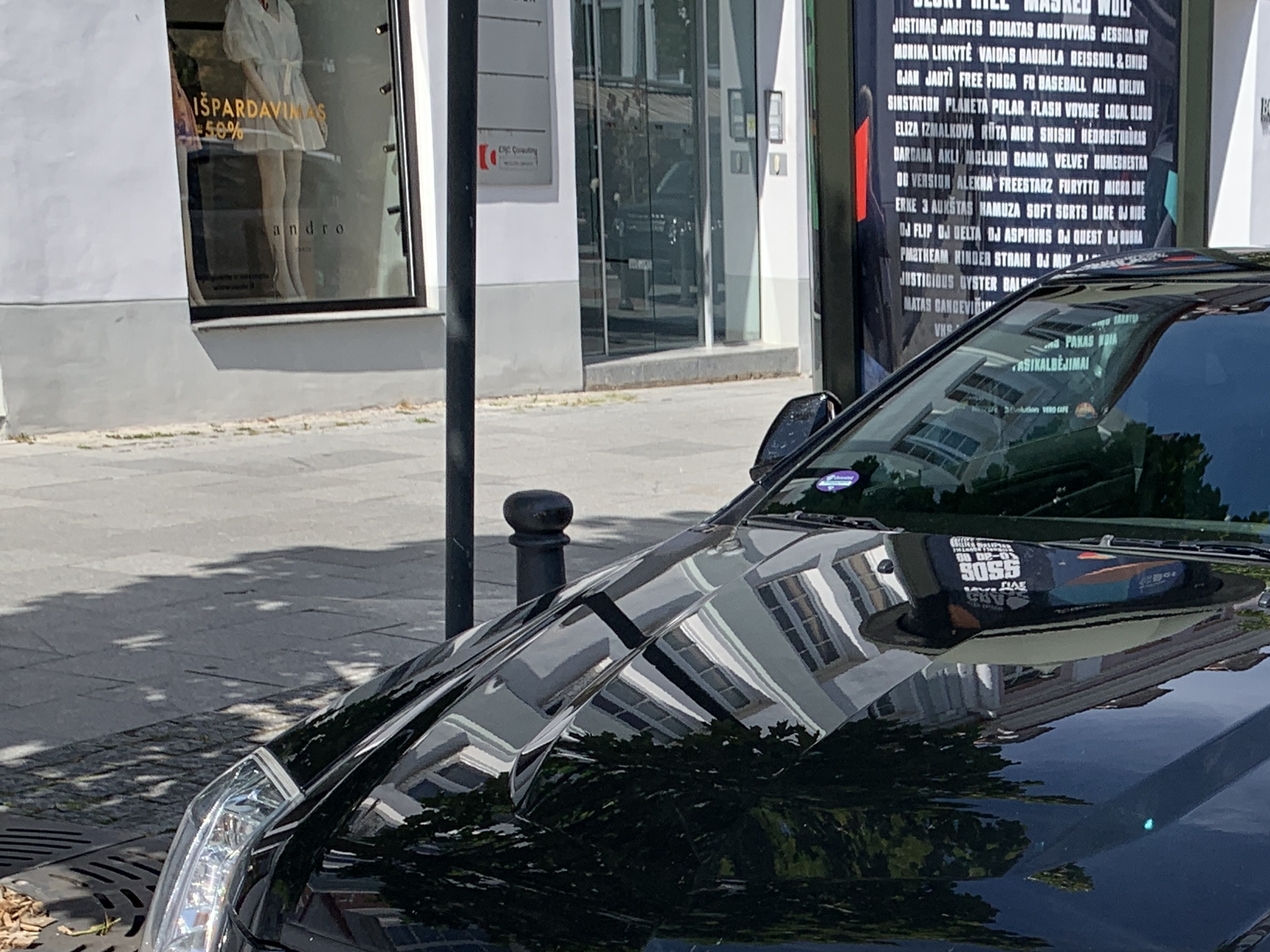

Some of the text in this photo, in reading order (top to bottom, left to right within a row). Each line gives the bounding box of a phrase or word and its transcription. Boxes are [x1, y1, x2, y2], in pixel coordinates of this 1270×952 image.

[892, 17, 938, 34] JUSTINAS
[940, 18, 983, 36] JARUTIS
[989, 20, 1034, 38] DONATAS
[1037, 22, 1096, 41] MONTVYDAS
[1101, 26, 1133, 44] JESSICA
[894, 43, 930, 60] MONIKA
[932, 42, 973, 62] LINKYTĖ
[979, 46, 1017, 63] VAIDAS
[1019, 47, 1064, 66] BAUMILA
[1070, 50, 1115, 69] BEISSOUL
[1117, 53, 1124, 70] &
[959, 71, 983, 88] FREE
[986, 72, 1017, 90] FINGA
[1038, 74, 1087, 93] BASEBALL
[1093, 77, 1117, 94] ALINA
[1119, 79, 1145, 96] ORLOVA
[194, 92, 327, 122] IŠPARDAVIMAS
[887, 95, 940, 112] SINSTATION
[945, 97, 988, 114] PLANETA
[992, 99, 1024, 116] POLAR
[1031, 100, 1062, 117] FLASH
[1065, 102, 1100, 119] VOYAGE
[1105, 103, 1128, 120] LOCAL
[895, 121, 919, 137] ELIZA
[921, 122, 975, 139] IZMALKOVA
[1010, 125, 1034, 142] MUR
[1040, 126, 1075, 144] SHISHI
[1054, 153, 1089, 170] VELVET
[911, 173, 951, 189] VERSION
[957, 175, 993, 192] ALEKNA
[999, 177, 1054, 194] FREESTARZ
[1058, 178, 1100, 196] FURYTTO
[1104, 180, 1130, 196] MICRO
[895, 197, 917, 214] ERKE
[922, 198, 929, 214] 3
[931, 196, 974, 216] AUKŠTAS
[1026, 203, 1053, 219] SOFT
[913, 223, 933, 239] FLIP
[938, 224, 950, 240] DJ
[953, 225, 981, 241] DELTA
[987, 226, 1001, 242] DJ
[1057, 229, 1071, 245] DJ
[1073, 229, 1103, 246] QUEST
[1107, 229, 1119, 245] DJ
[1036, 253, 1049, 269] DJ
[1053, 253, 1072, 269] MIX
[899, 271, 954, 289] JUSTICIOUS
[960, 275, 998, 292] OYSTER
[904, 296, 932, 313] MATAS
[1012, 354, 1089, 372] ASIKALBĖJIMAI
